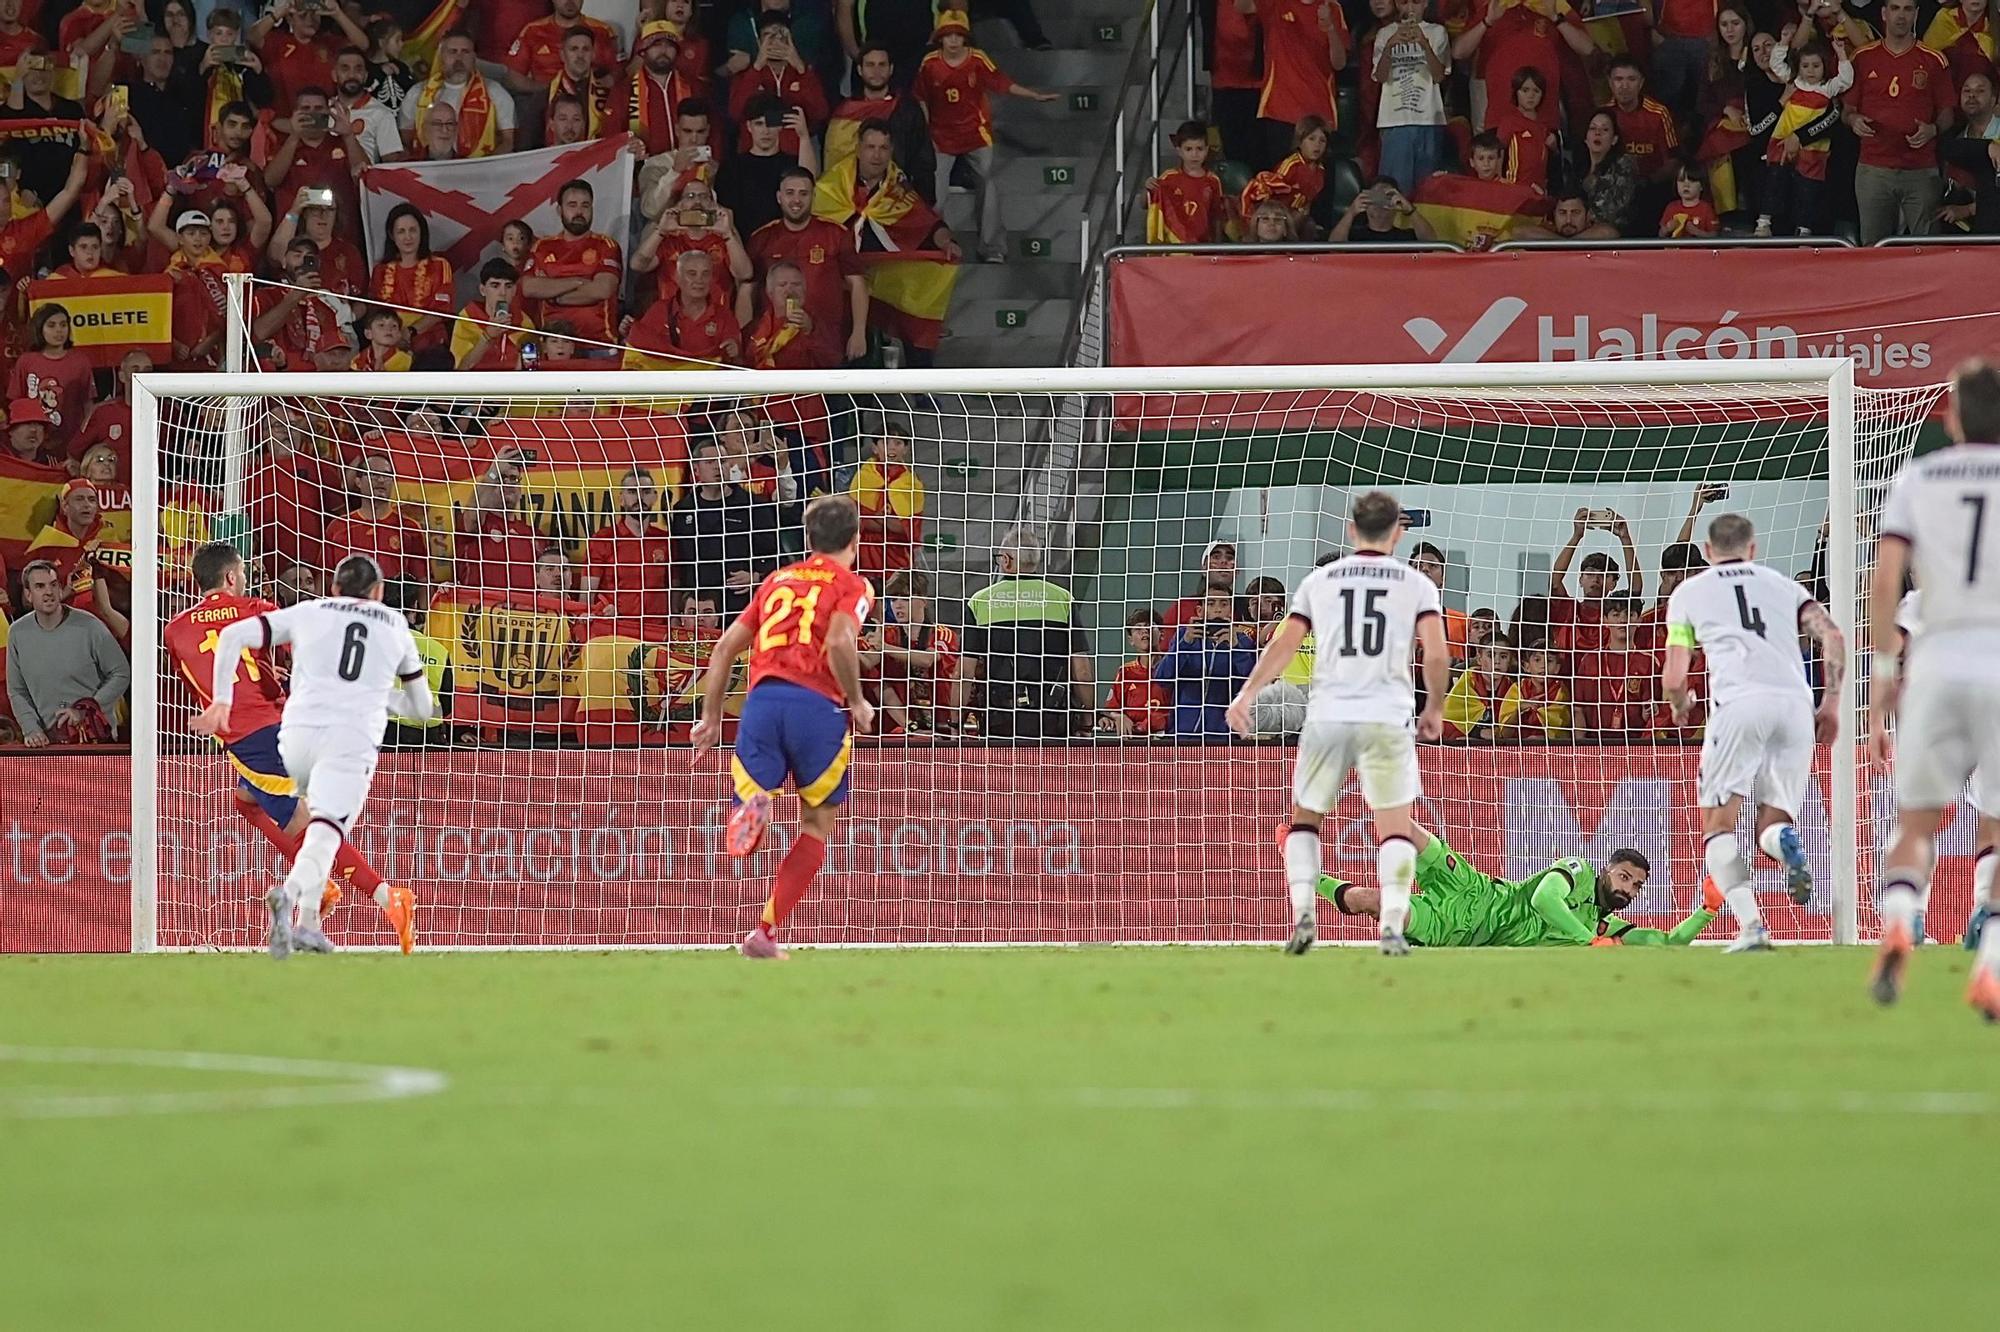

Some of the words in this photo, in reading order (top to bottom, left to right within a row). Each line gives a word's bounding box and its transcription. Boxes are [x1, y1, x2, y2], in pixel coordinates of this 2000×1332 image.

[1100, 28, 1115, 40] 12
[945, 88, 960, 103] 19
[1888, 76, 1900, 97] 6
[1077, 96, 1089, 109] 11
[1050, 168, 1068, 182] 10
[1030, 240, 1041, 254] 9
[68, 310, 149, 329] OBLETE
[1006, 312, 1018, 326] 8
[1537, 309, 1799, 363] Halcón
[1806, 332, 1932, 378] viajes
[1961, 494, 1985, 583] 7
[190, 606, 239, 625] FERRAN
[759, 584, 822, 653] 21
[1733, 584, 1767, 640] 4
[1339, 588, 1388, 657] 15
[338, 621, 368, 683] 6
[699, 804, 1083, 877] fnnciera
